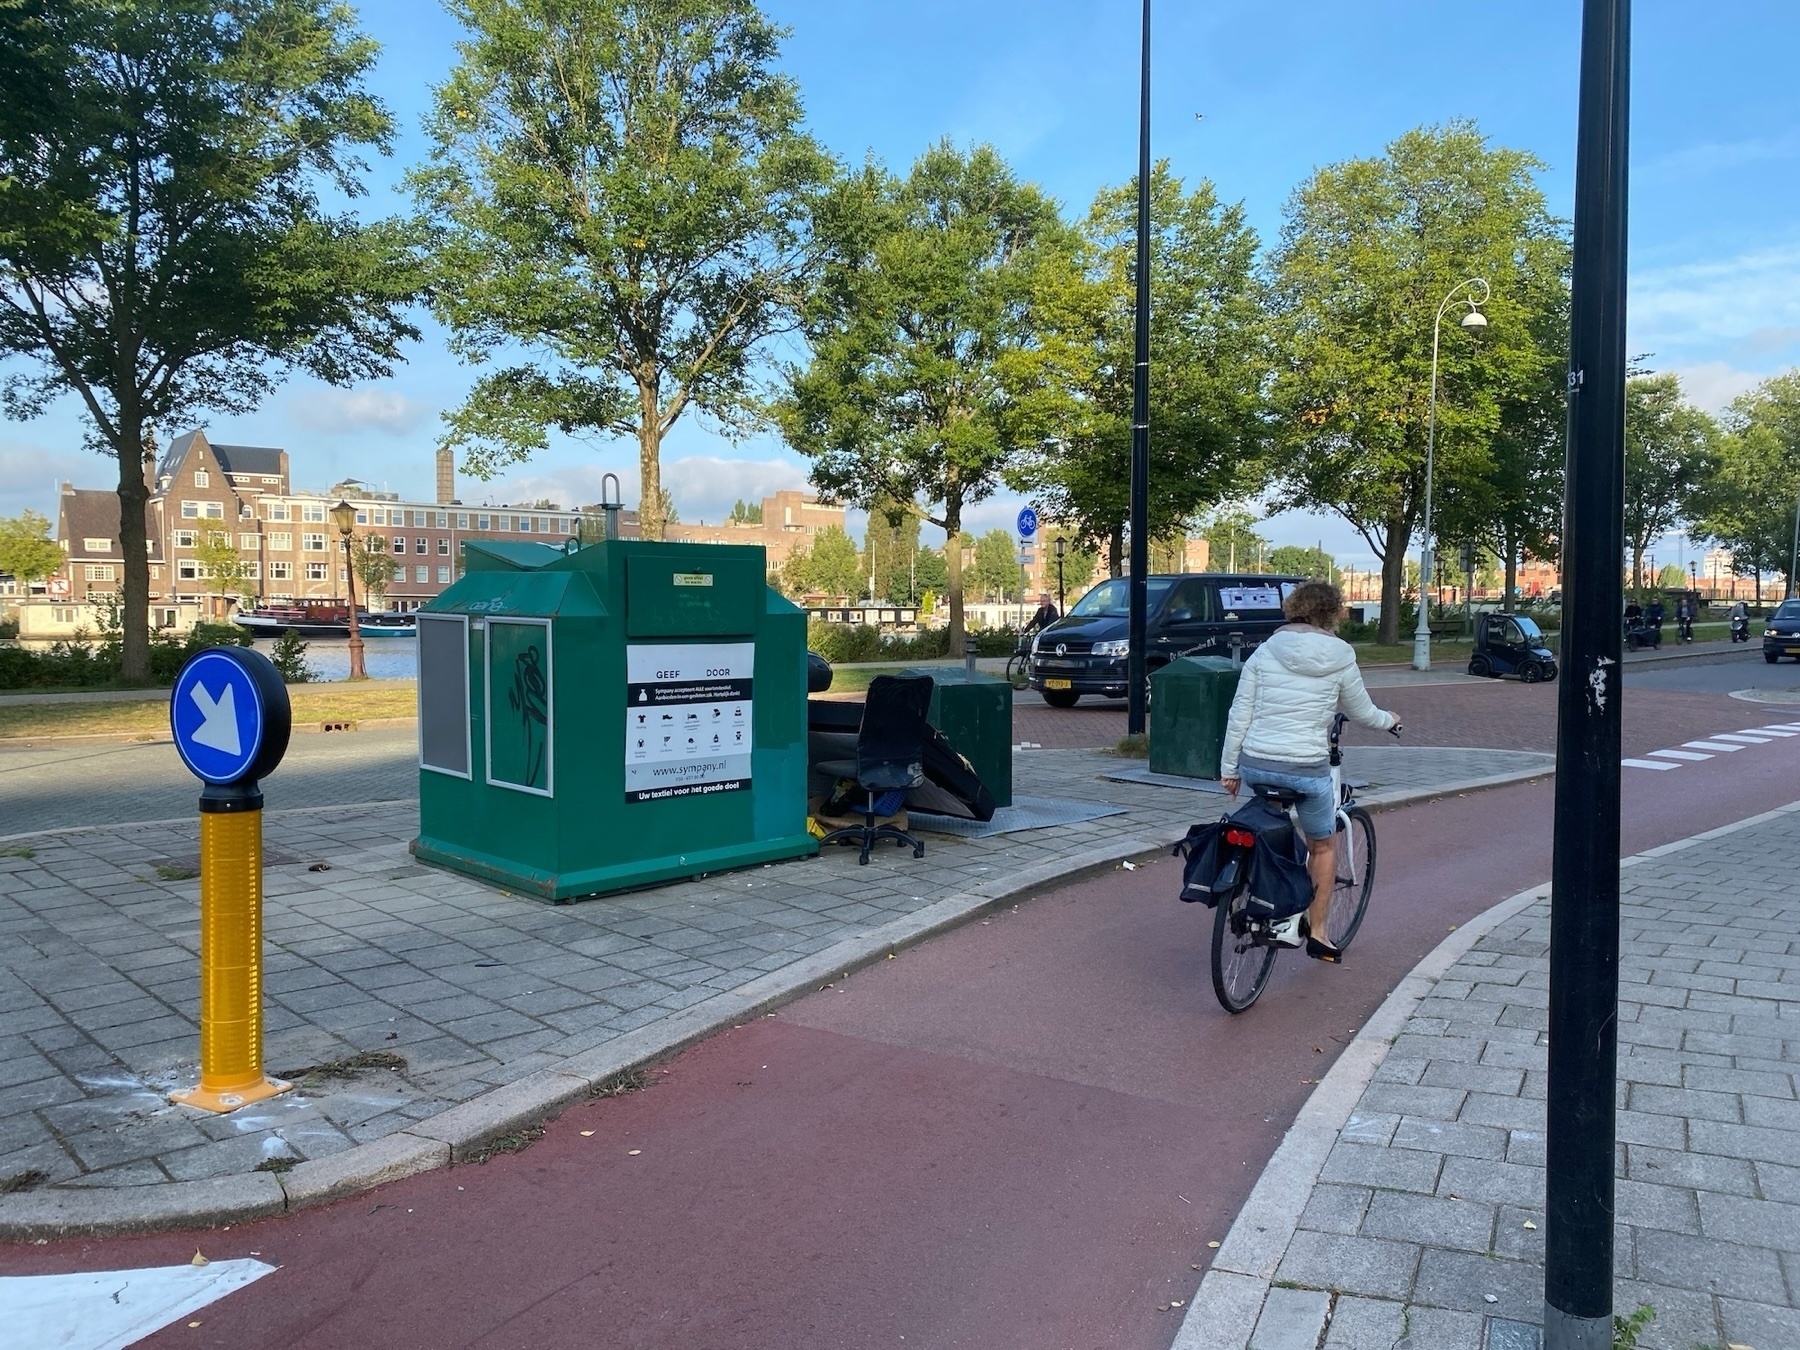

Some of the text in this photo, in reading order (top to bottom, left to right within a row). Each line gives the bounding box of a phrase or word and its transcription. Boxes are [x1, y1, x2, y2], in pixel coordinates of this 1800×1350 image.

[656, 668, 730, 679] GEEF DOOR
[653, 760, 727, 776] www.sympany.nl
[639, 781, 740, 800] Uw textiel voor het goede doel
